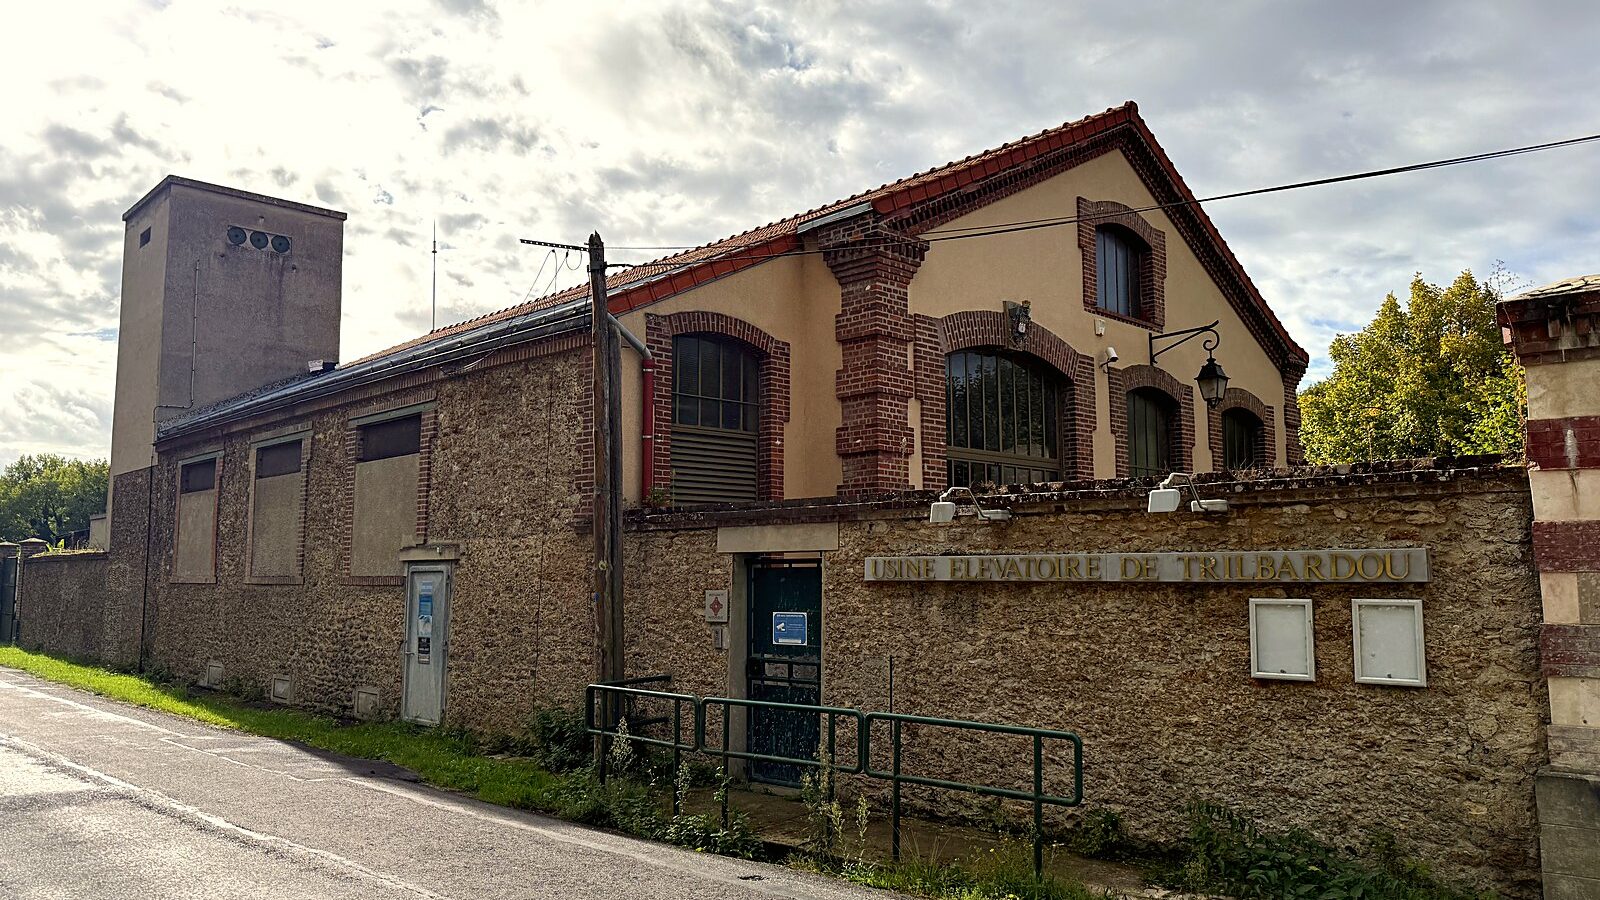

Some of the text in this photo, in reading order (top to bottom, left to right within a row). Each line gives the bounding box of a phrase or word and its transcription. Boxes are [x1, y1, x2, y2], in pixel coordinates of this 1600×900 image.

[871, 552, 1410, 580] USINE ELEVATOIRE DE TRILBARDOU
